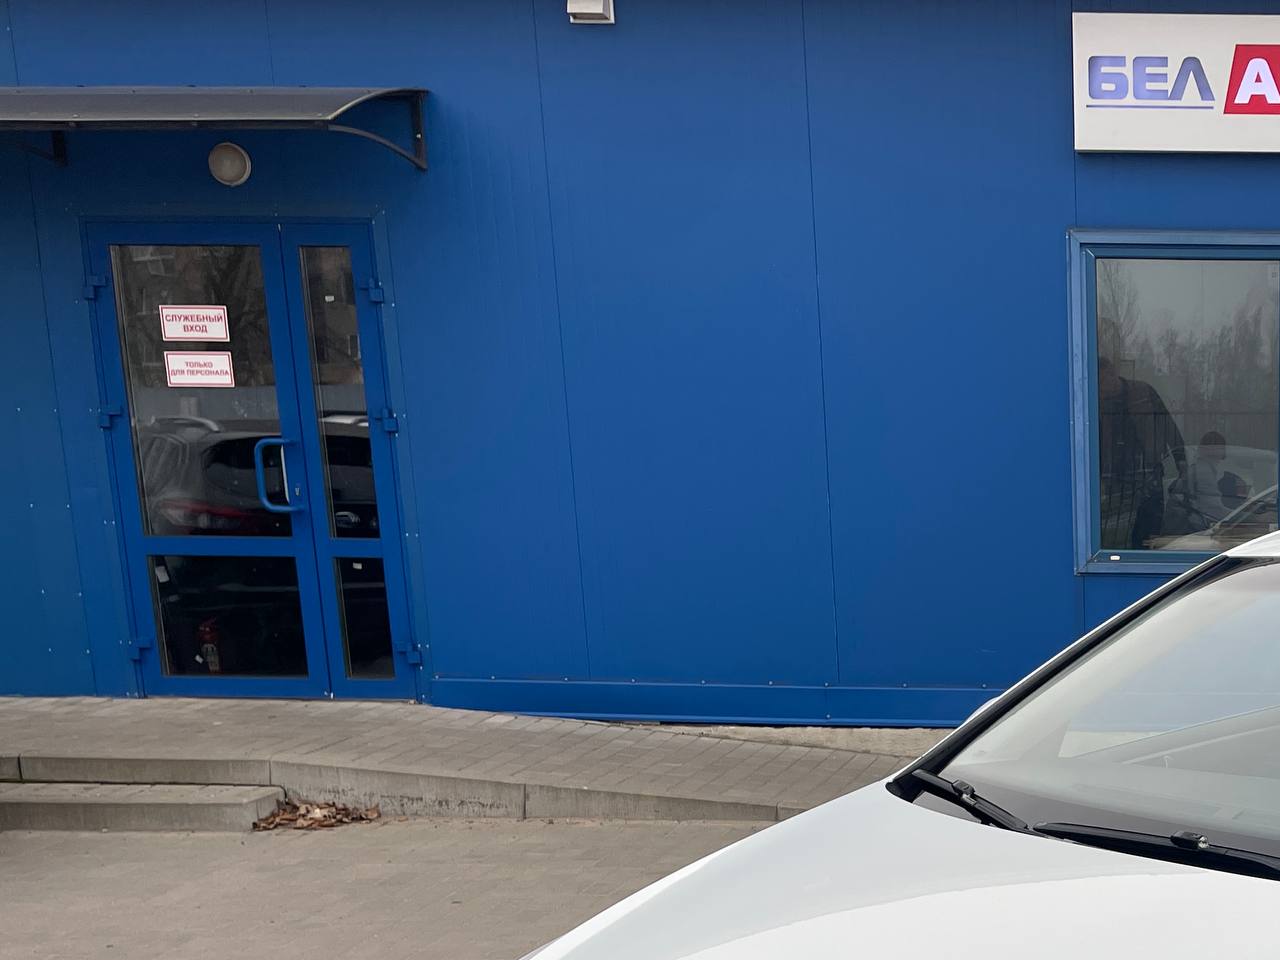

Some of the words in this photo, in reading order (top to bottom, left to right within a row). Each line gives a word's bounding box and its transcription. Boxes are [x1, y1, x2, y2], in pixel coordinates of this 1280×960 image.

[1088, 55, 1215, 102] БЕЛ
[165, 313, 223, 322] СЛУЖЕБНЫЙ
[183, 324, 208, 334] ВХОД
[185, 361, 213, 369] ТОЛЬКО
[171, 369, 185, 377] ДЛЯ
[188, 369, 230, 377] ПЕРСОНАЛА
